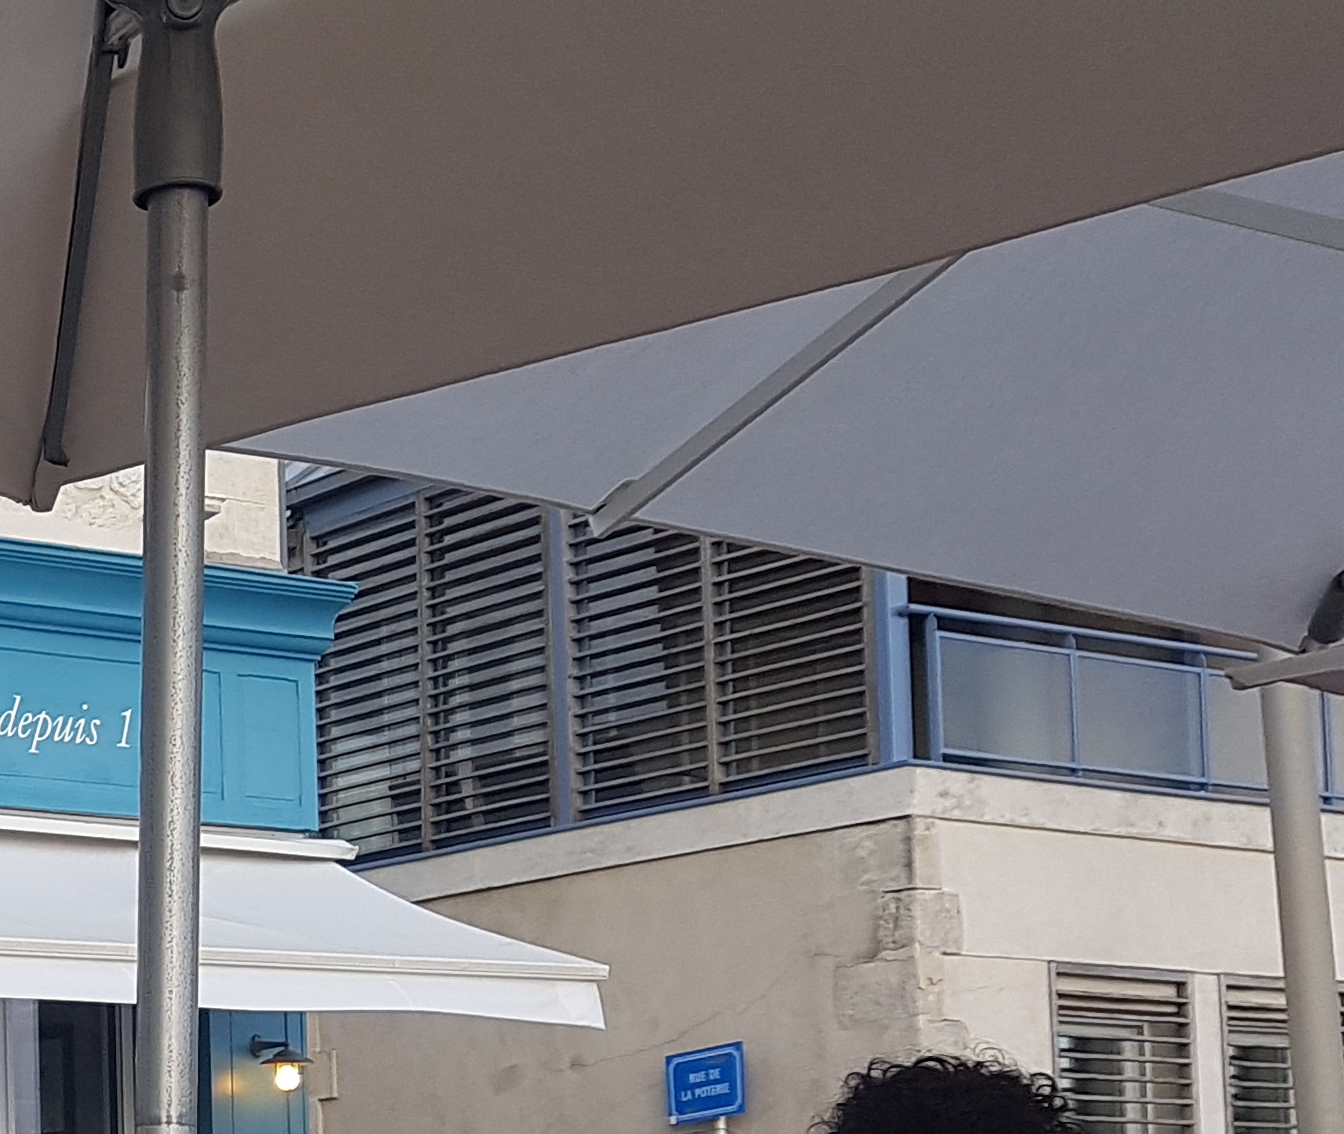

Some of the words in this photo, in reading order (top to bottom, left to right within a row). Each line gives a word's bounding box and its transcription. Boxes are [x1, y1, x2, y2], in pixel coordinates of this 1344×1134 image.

[115, 707, 135, 748] 1
[689, 1071, 706, 1083] RUE
[709, 1068, 721, 1079] DE
[681, 1090, 692, 1101] LA
